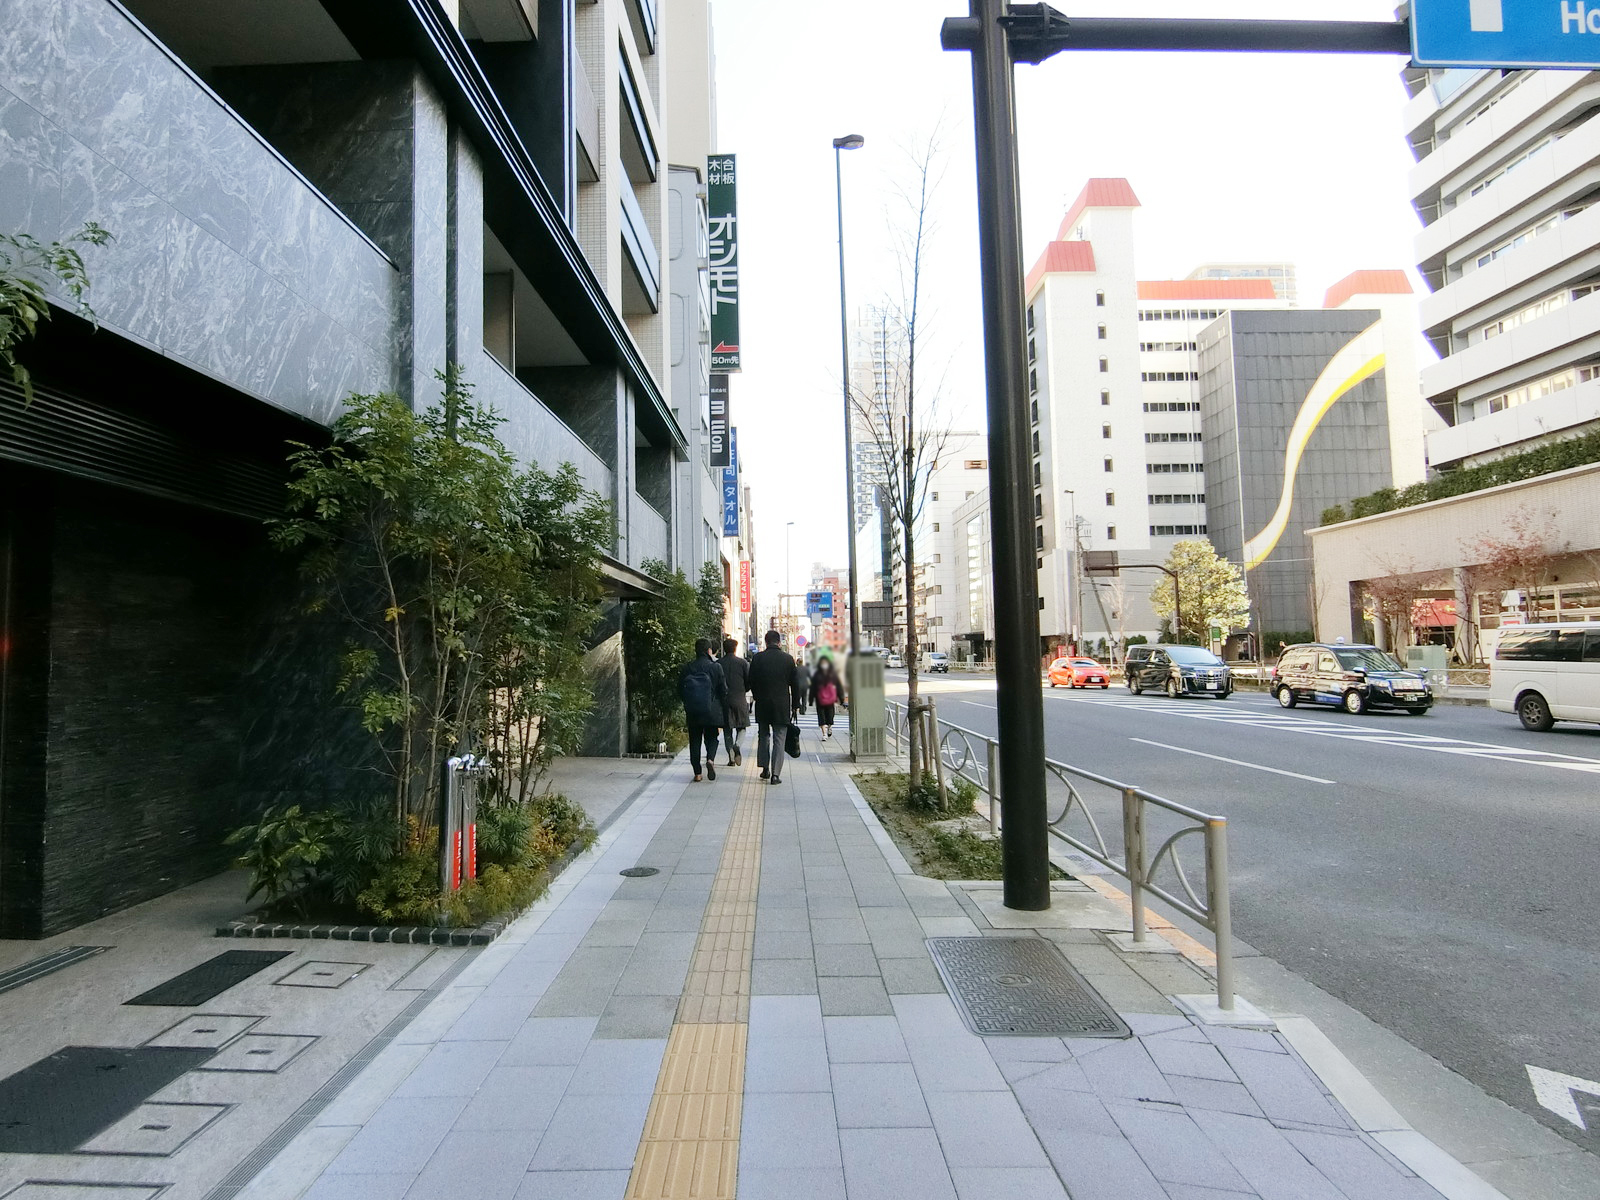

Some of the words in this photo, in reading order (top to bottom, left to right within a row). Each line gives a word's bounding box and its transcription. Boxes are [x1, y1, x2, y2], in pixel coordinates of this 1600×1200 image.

[708, 159, 721, 185] 木材
[722, 158, 735, 185] 合板
[709, 213, 737, 315] オシモト
[711, 355, 739, 365] 50m先
[724, 486, 737, 525] タオル
